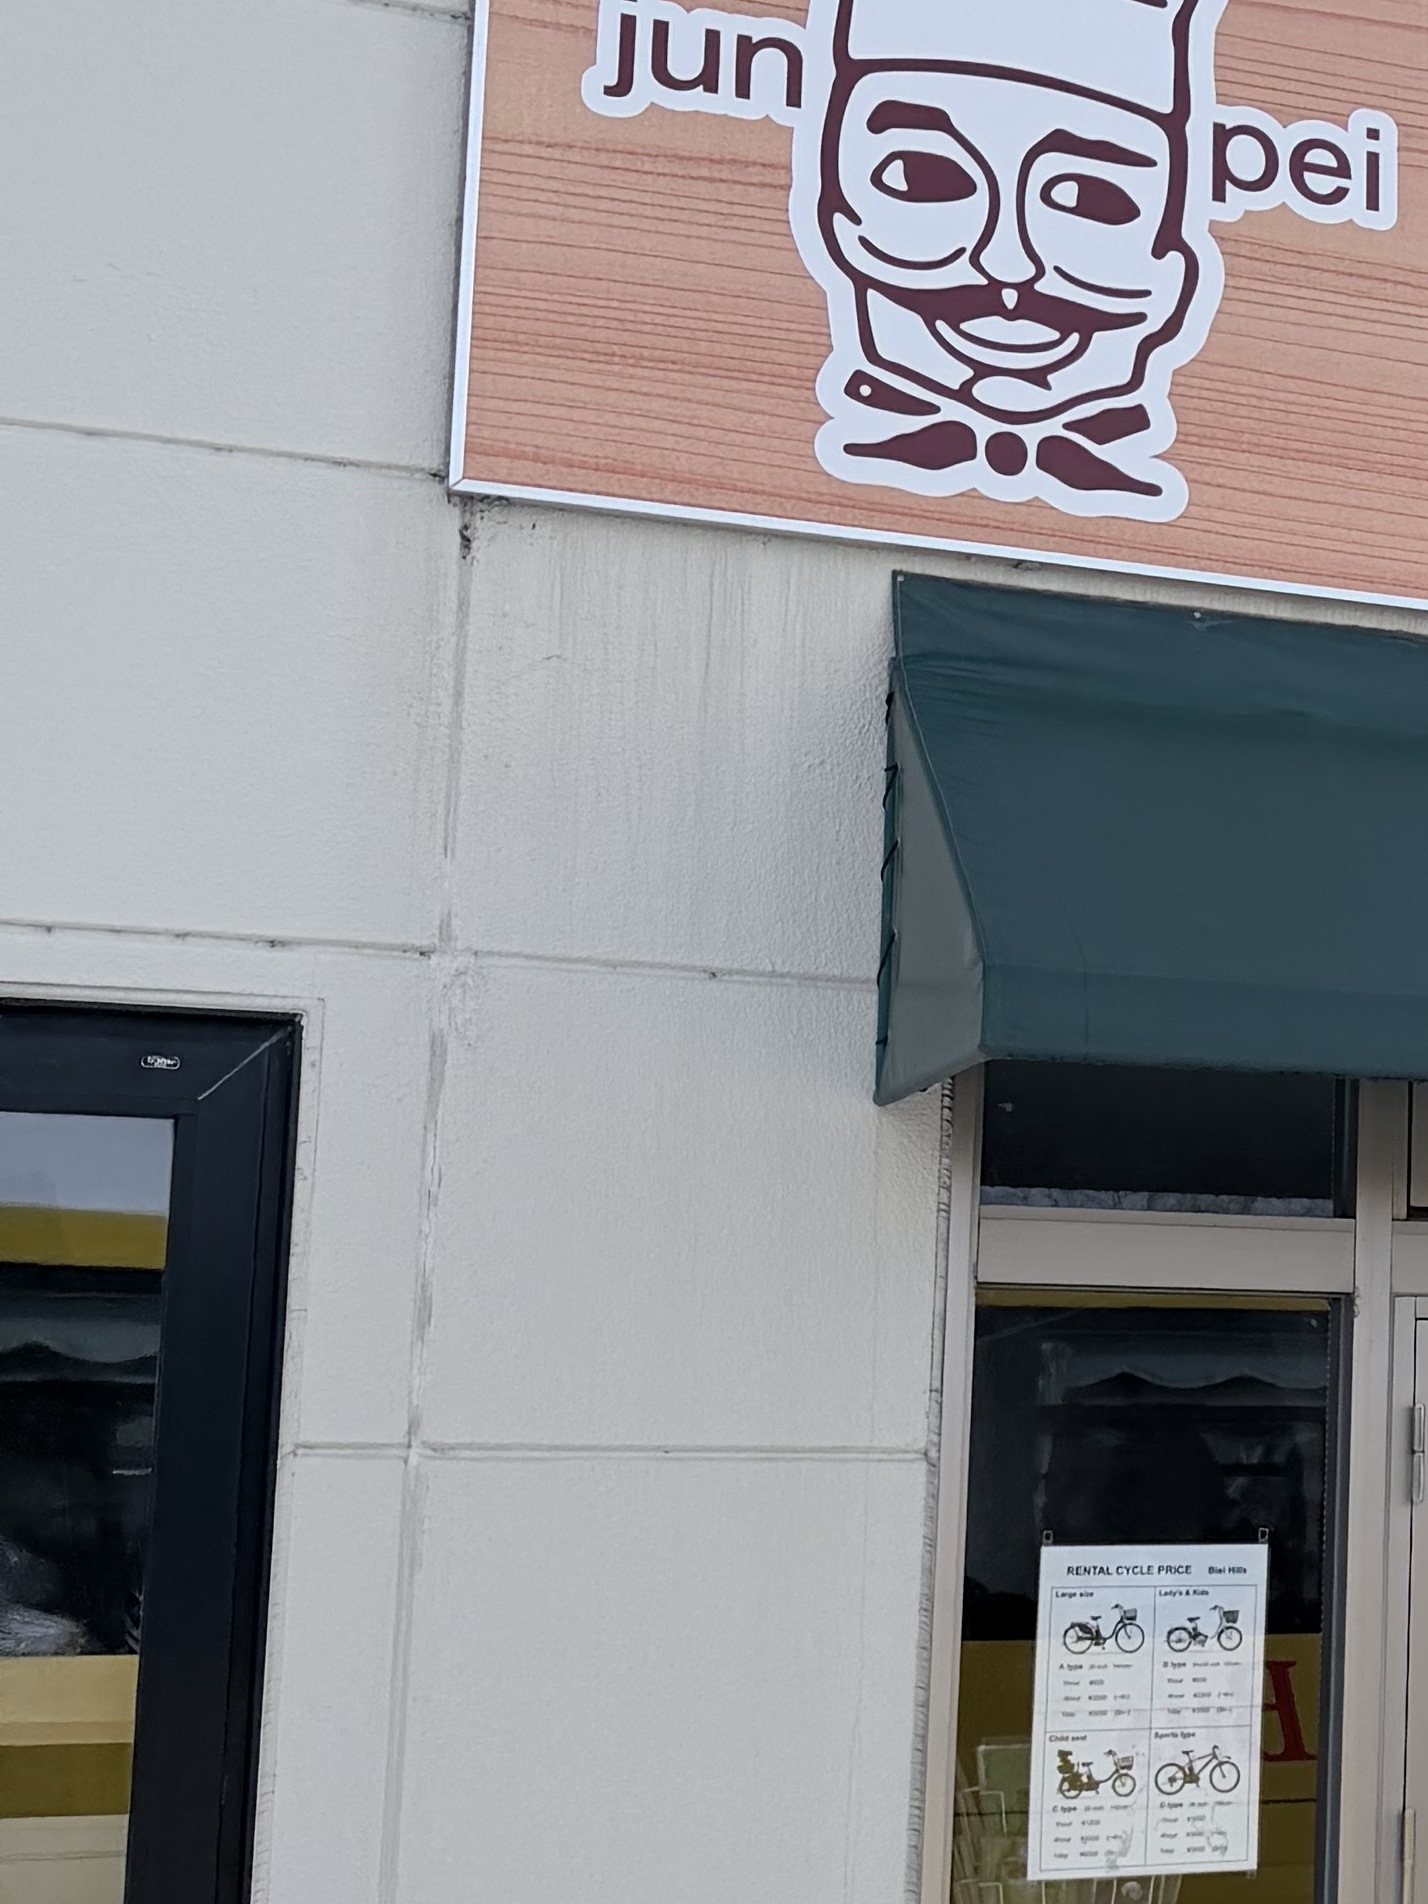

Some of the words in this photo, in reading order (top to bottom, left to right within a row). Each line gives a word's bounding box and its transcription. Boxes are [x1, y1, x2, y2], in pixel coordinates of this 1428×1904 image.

[1214, 116, 1382, 218] pei
[1066, 1565, 1113, 1576] RENTAL
[1115, 1565, 1154, 1576] CYCLE
[1157, 1564, 1193, 1575] PRICE
